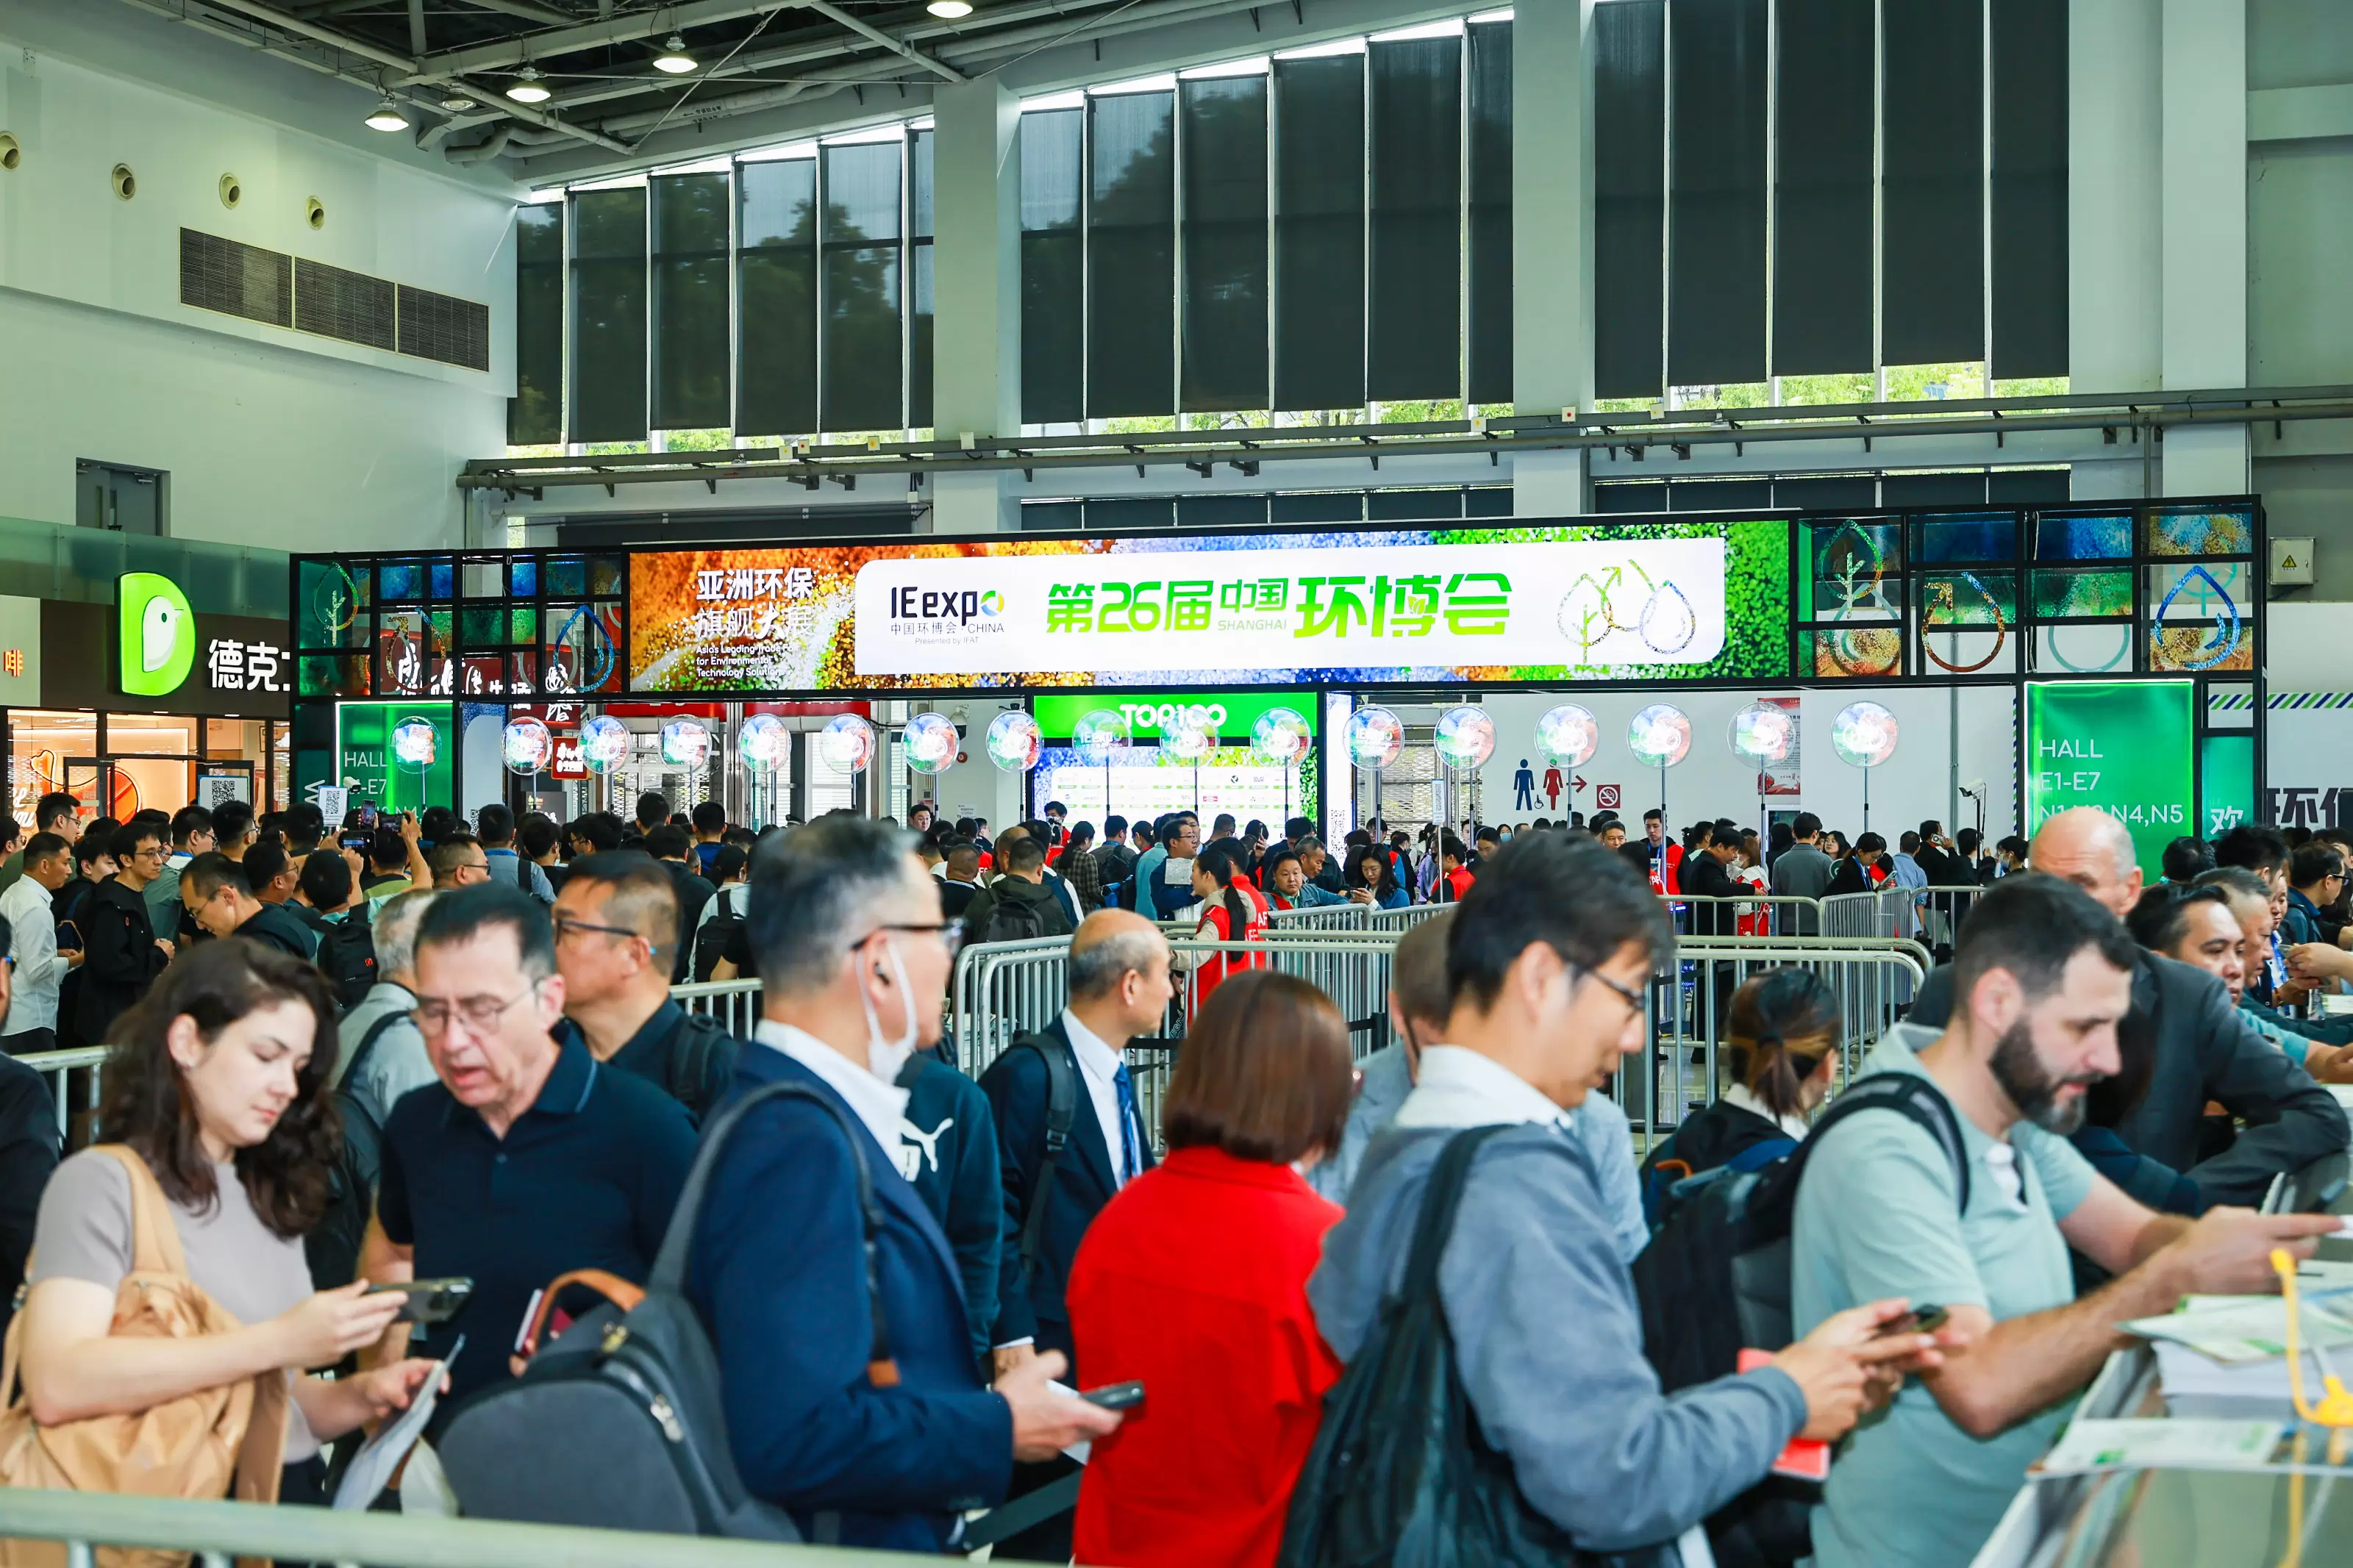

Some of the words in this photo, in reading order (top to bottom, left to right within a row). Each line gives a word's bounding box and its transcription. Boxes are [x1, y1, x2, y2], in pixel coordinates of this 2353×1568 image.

[696, 567, 813, 601] 亚洲环保
[696, 601, 813, 640] 旗舰大展
[891, 621, 957, 635] 中国环博会
[968, 623, 1004, 634] CHINA
[1218, 619, 1287, 631] SHANGHAI
[721, 644, 755, 654] Leading
[757, 644, 782, 653] Trade
[952, 637, 961, 645] by
[4, 649, 24, 676] 啡
[208, 639, 290, 692] 德克
[696, 656, 708, 665] for
[710, 655, 772, 665] Environmental
[697, 667, 743, 679] Technology
[2039, 739, 2103, 758] HALL
[344, 751, 388, 767] HALL
[2040, 772, 2101, 792] E1-E7
